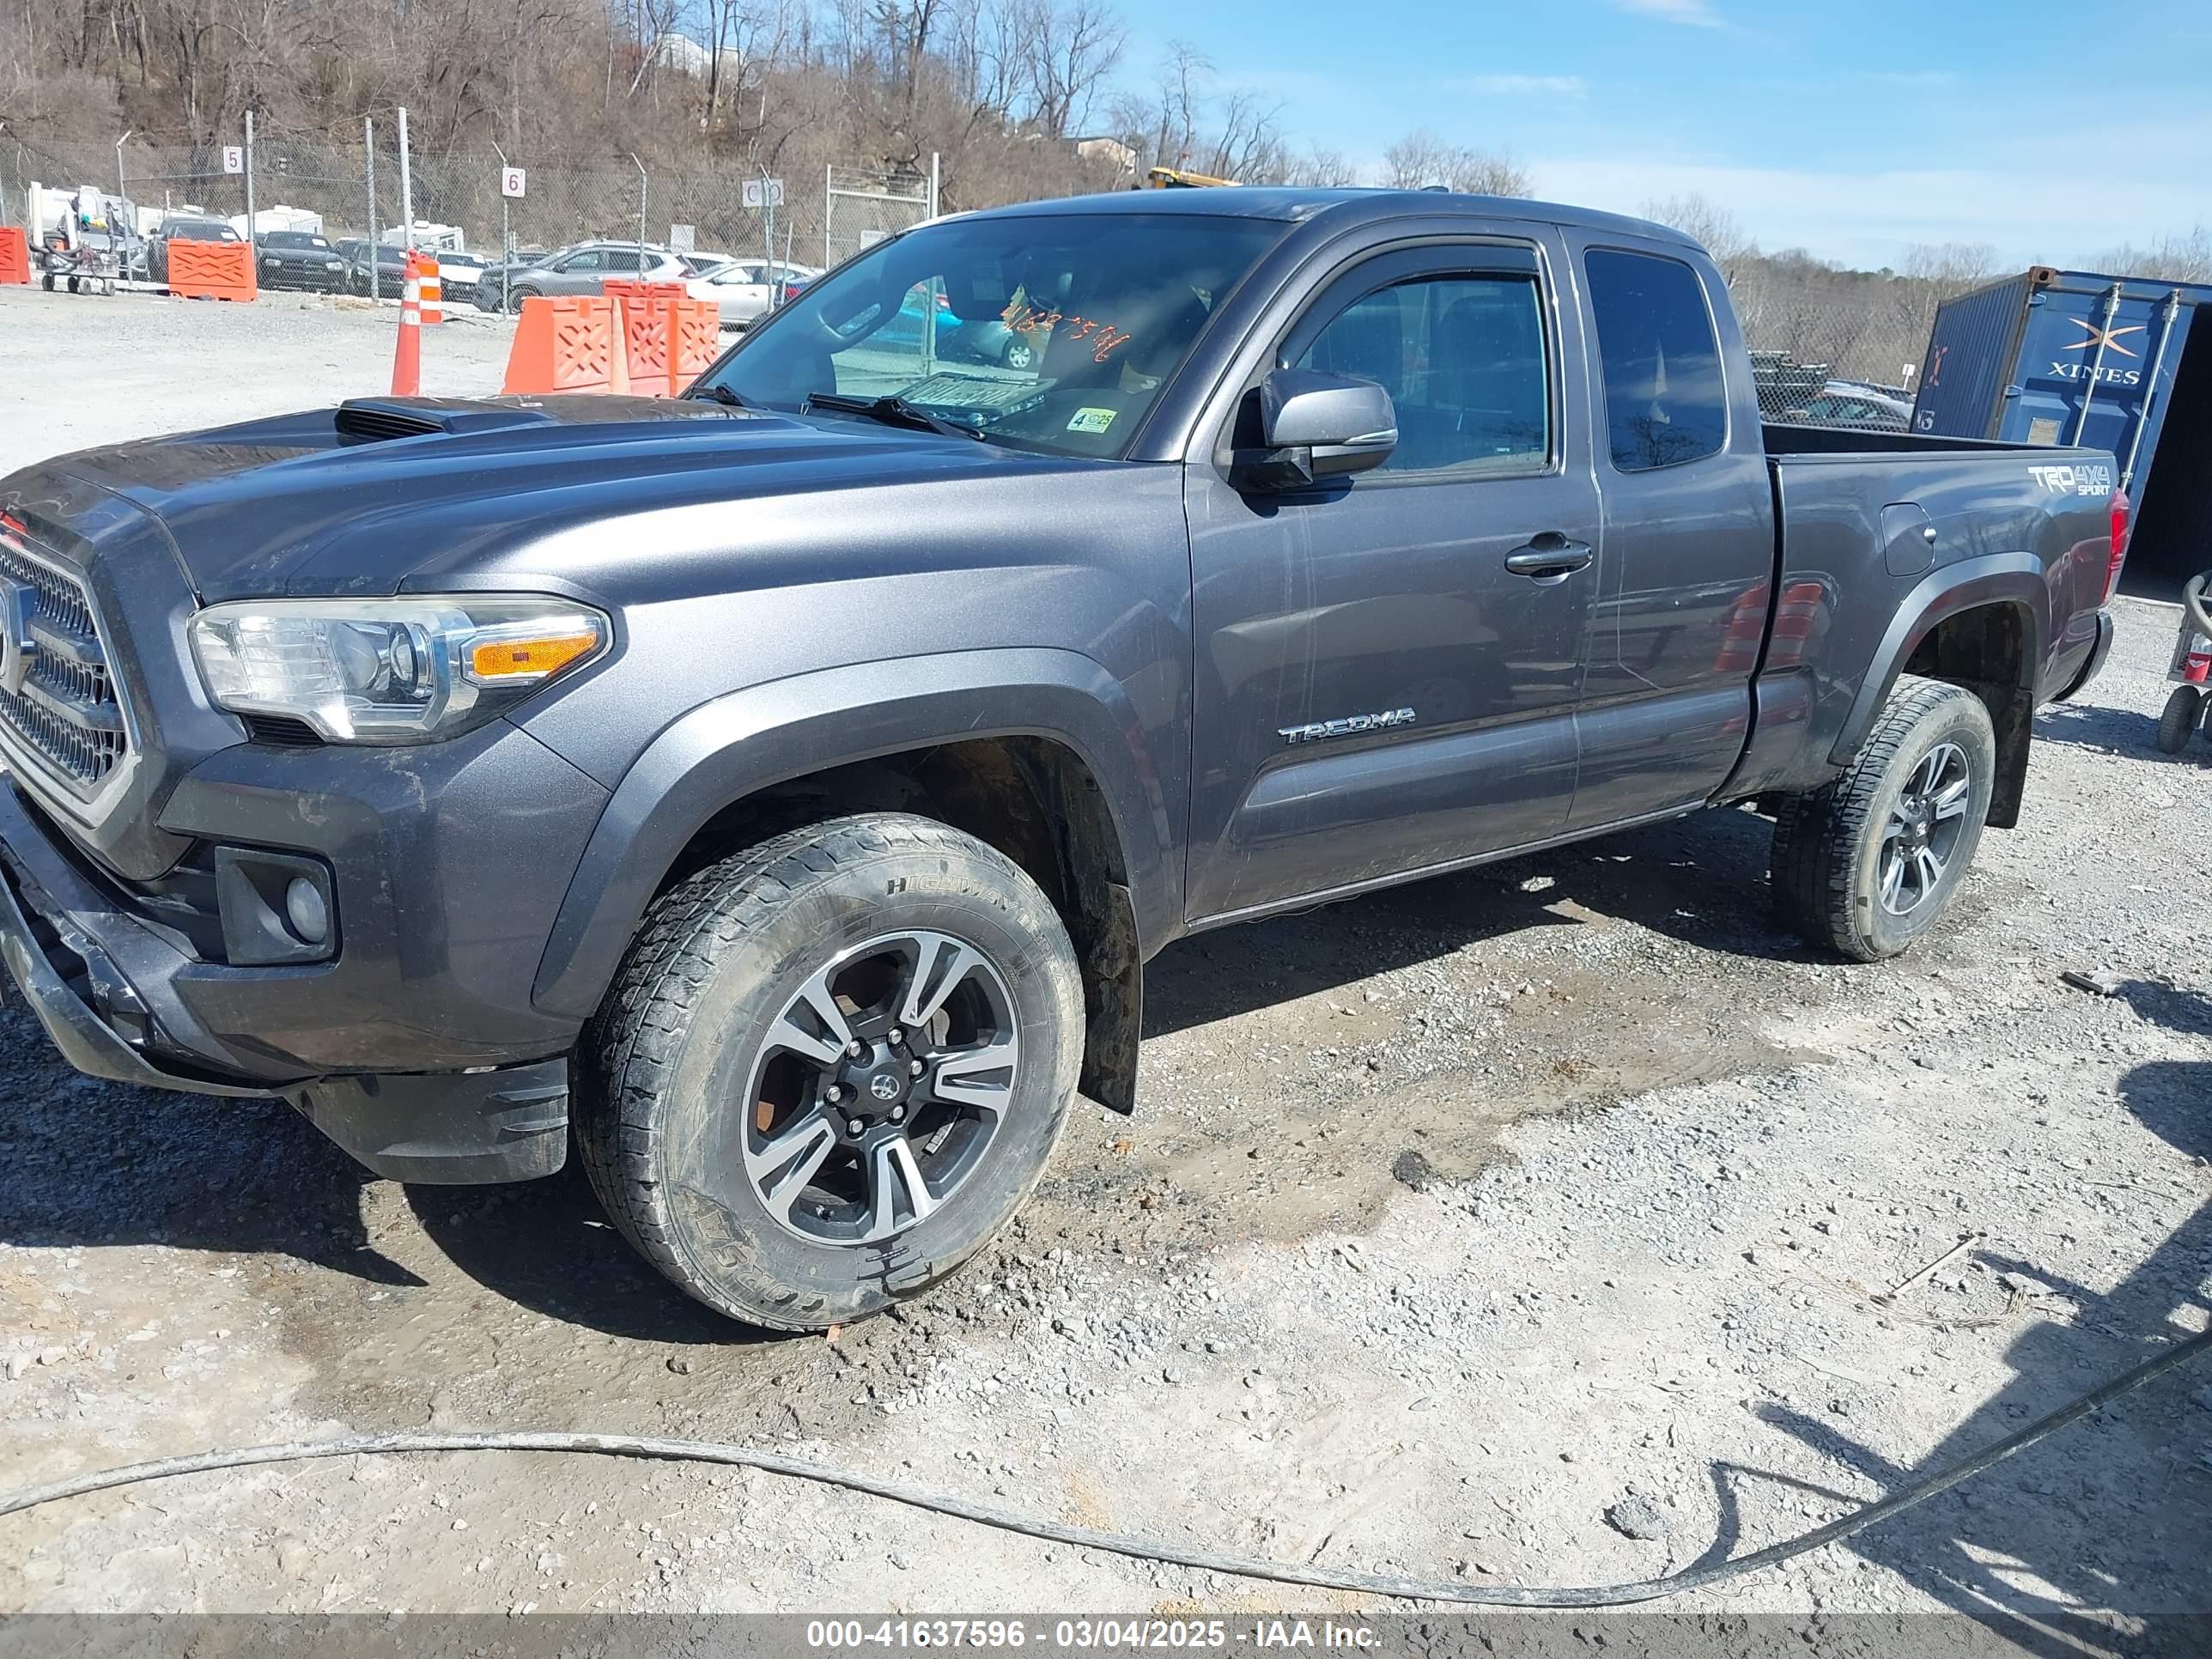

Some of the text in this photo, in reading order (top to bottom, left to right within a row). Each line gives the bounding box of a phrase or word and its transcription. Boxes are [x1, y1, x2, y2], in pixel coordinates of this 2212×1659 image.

[229, 151, 238, 168] 5
[509, 173, 519, 191] 6
[2047, 362, 2141, 385] XINES
[1073, 413, 1113, 426] 4 25
[2027, 465, 2075, 493] TRD
[2078, 484, 2111, 495] SPORT
[1278, 707, 1417, 744] TACOMA
[886, 874, 1018, 912] HIGHWAY
[696, 1209, 831, 1313] CORSA
